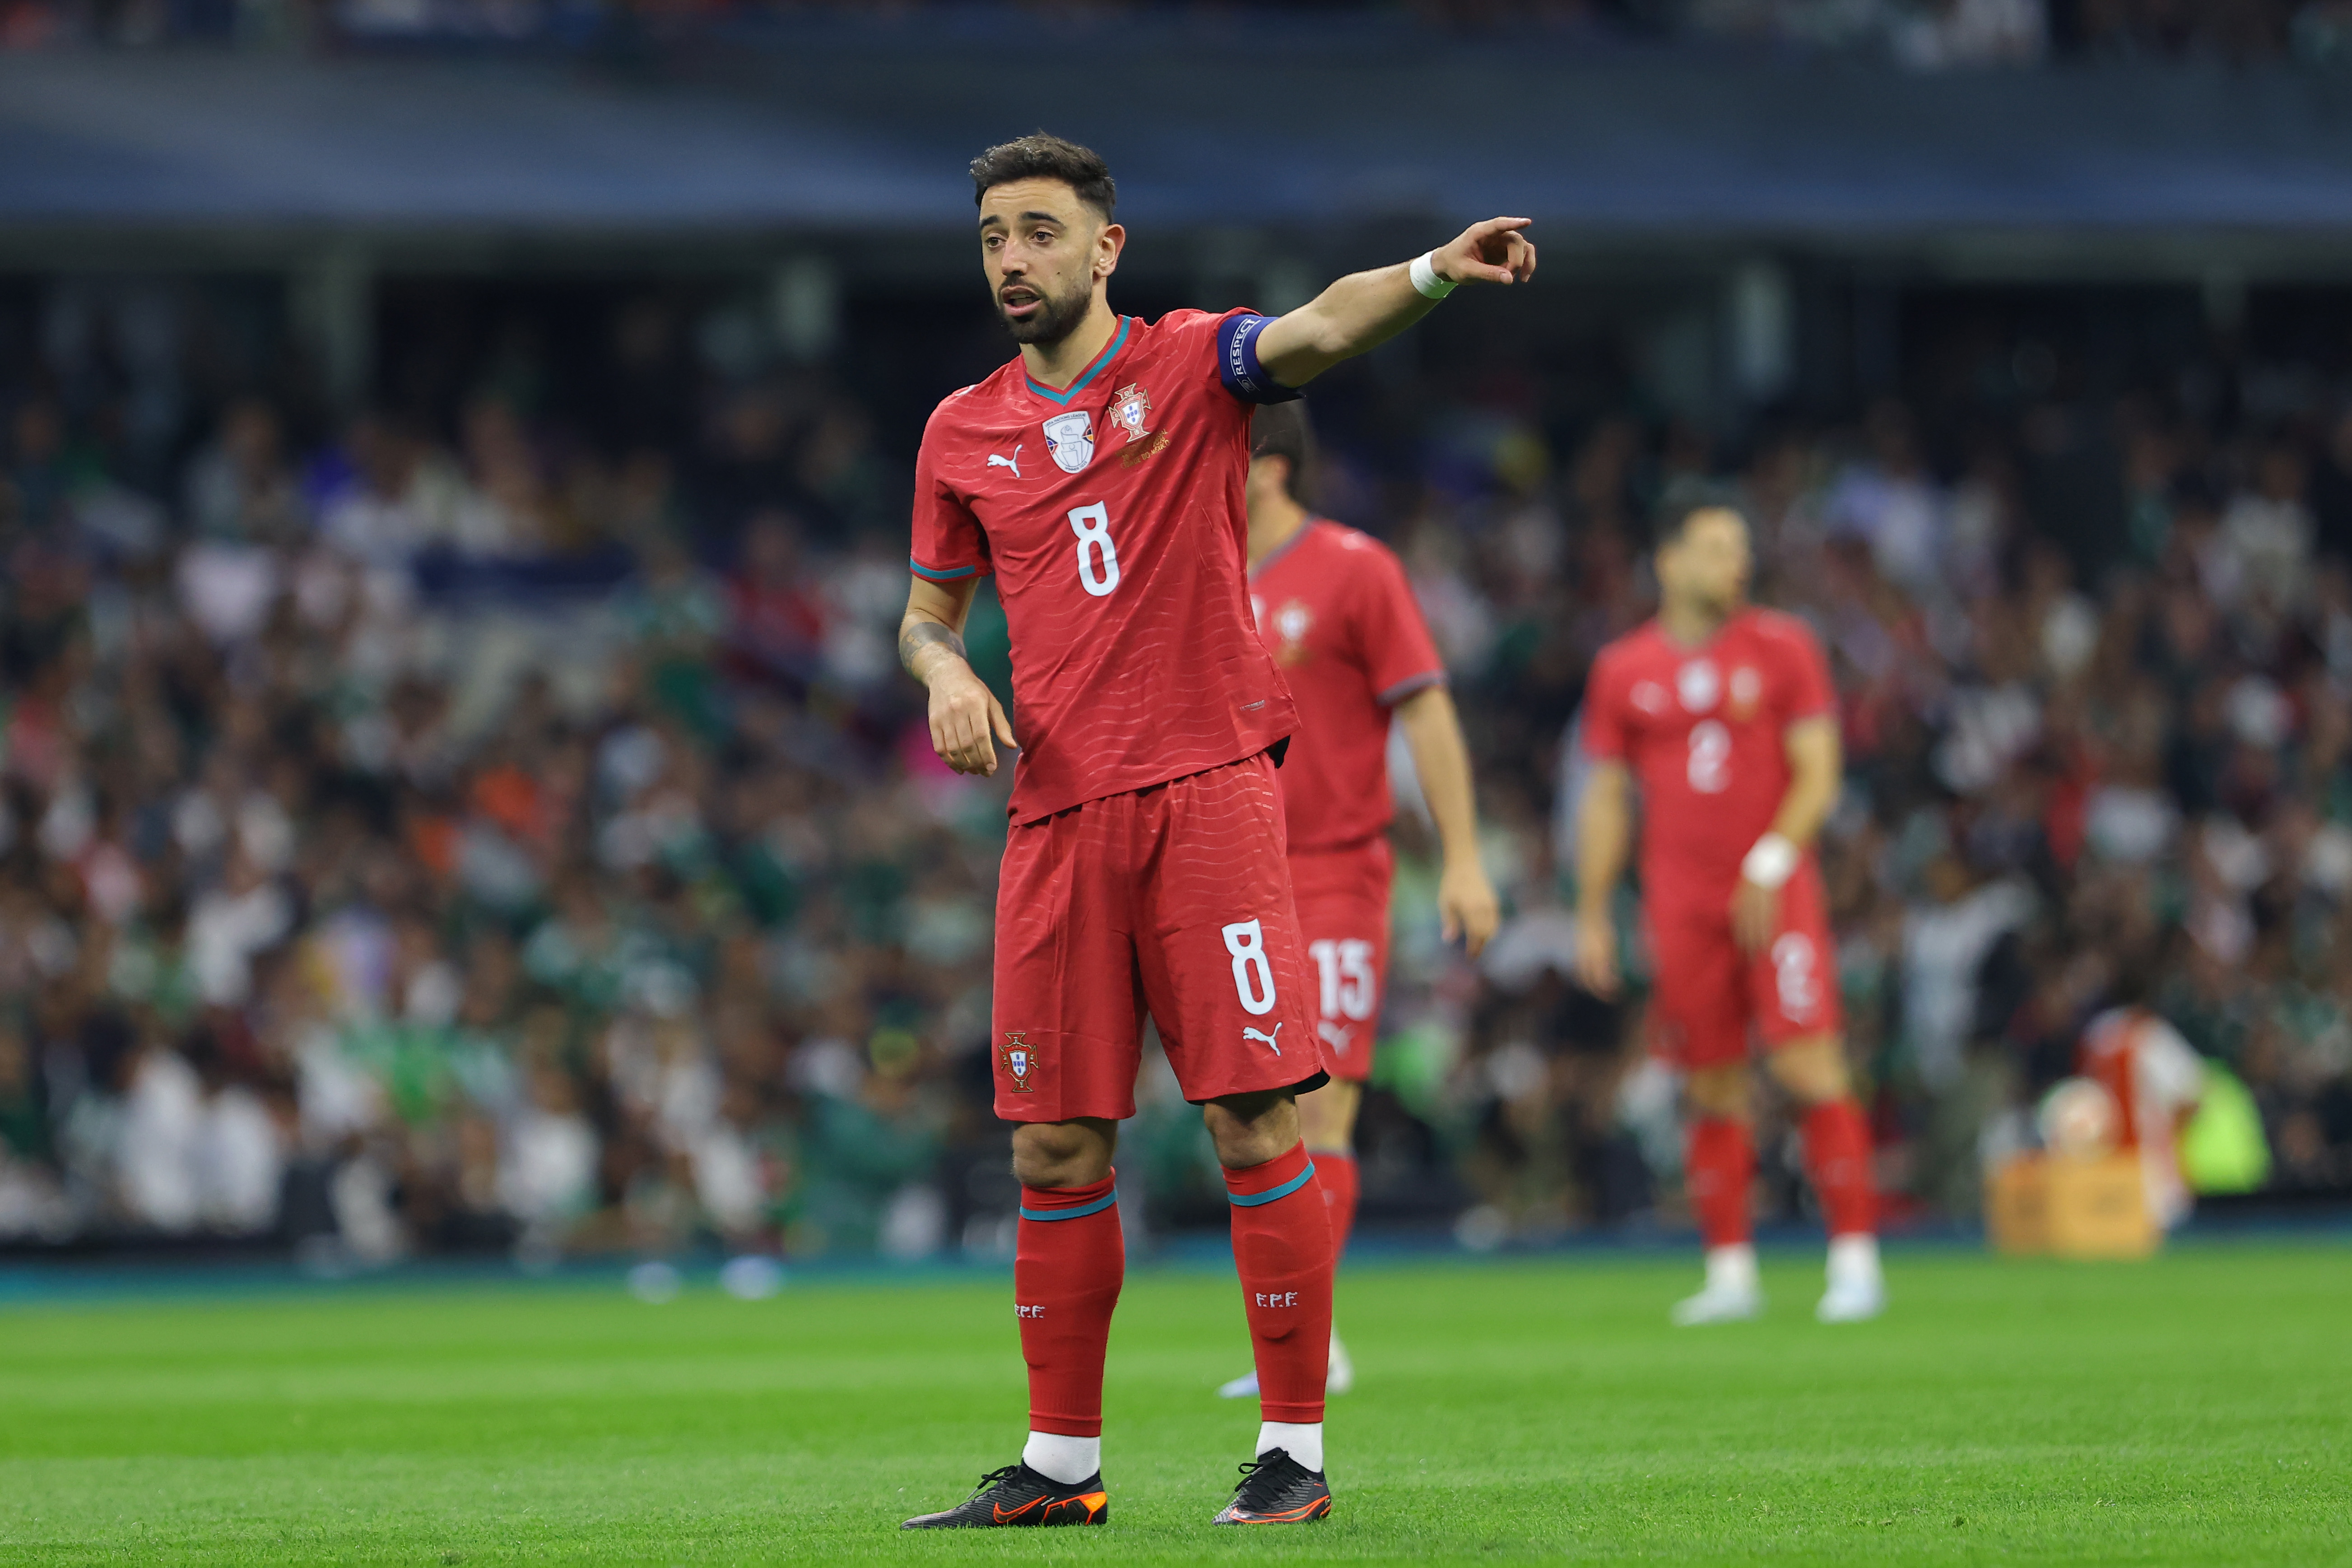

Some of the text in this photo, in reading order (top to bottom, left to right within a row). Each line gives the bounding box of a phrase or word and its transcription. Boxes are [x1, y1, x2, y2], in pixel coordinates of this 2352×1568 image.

[1232, 318, 1255, 375] RESPECT
[1067, 500, 1120, 596] 8
[1687, 719, 1733, 795] 2
[1221, 918, 1277, 1015] 8
[1308, 935, 1376, 1021] 15
[1255, 1292, 1298, 1308] F.P.F.
